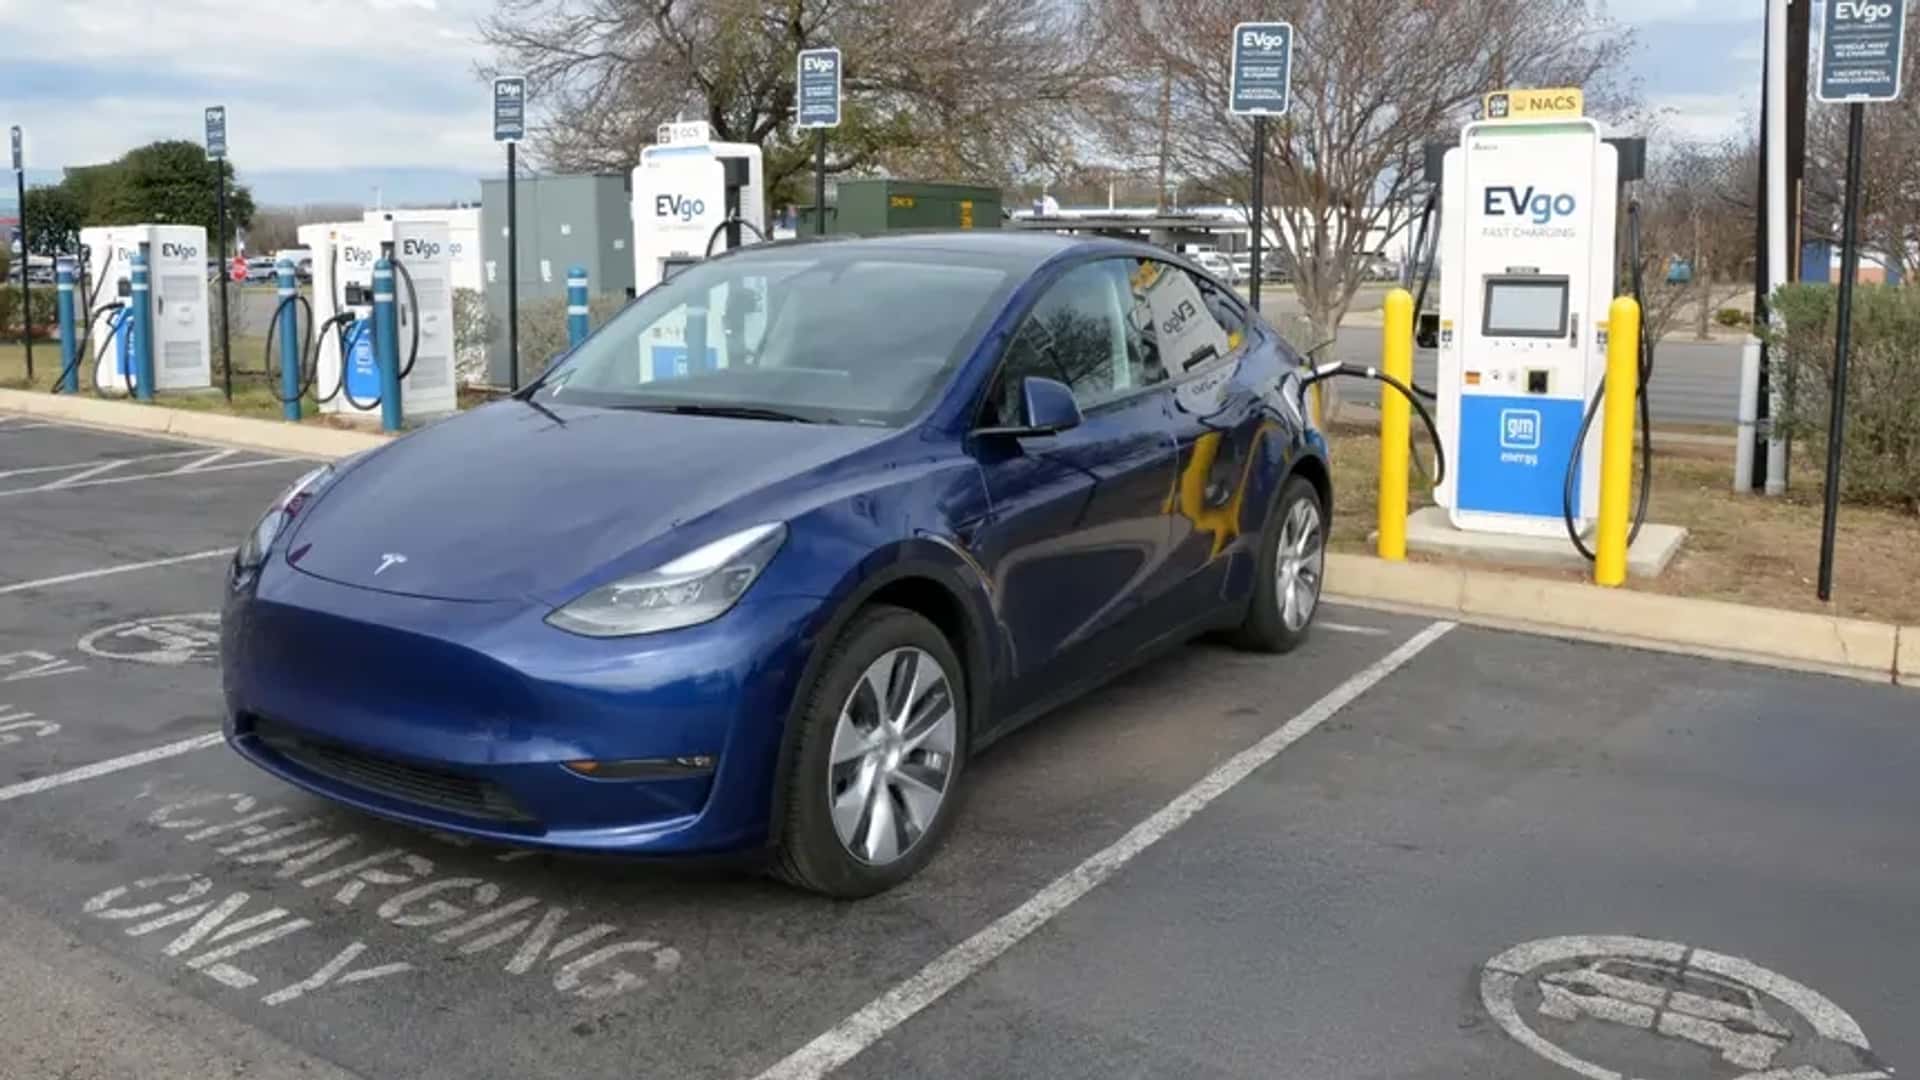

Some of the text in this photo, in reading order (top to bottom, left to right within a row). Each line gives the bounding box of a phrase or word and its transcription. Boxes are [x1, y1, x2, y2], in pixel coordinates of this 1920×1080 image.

[1835, 0, 1892, 23] EVgo
[1242, 31, 1283, 51] EVgo
[804, 56, 834, 73] EVgo
[1530, 95, 1576, 111] NACS
[656, 193, 705, 221] EVgo
[1484, 186, 1576, 224] EVgo
[162, 242, 198, 261] EVgo
[344, 246, 373, 266] EVgo
[403, 238, 441, 259] EVgo
[1507, 418, 1534, 439] gm
[148, 791, 682, 999] CHARGING
[81, 872, 414, 1007] ONLY
